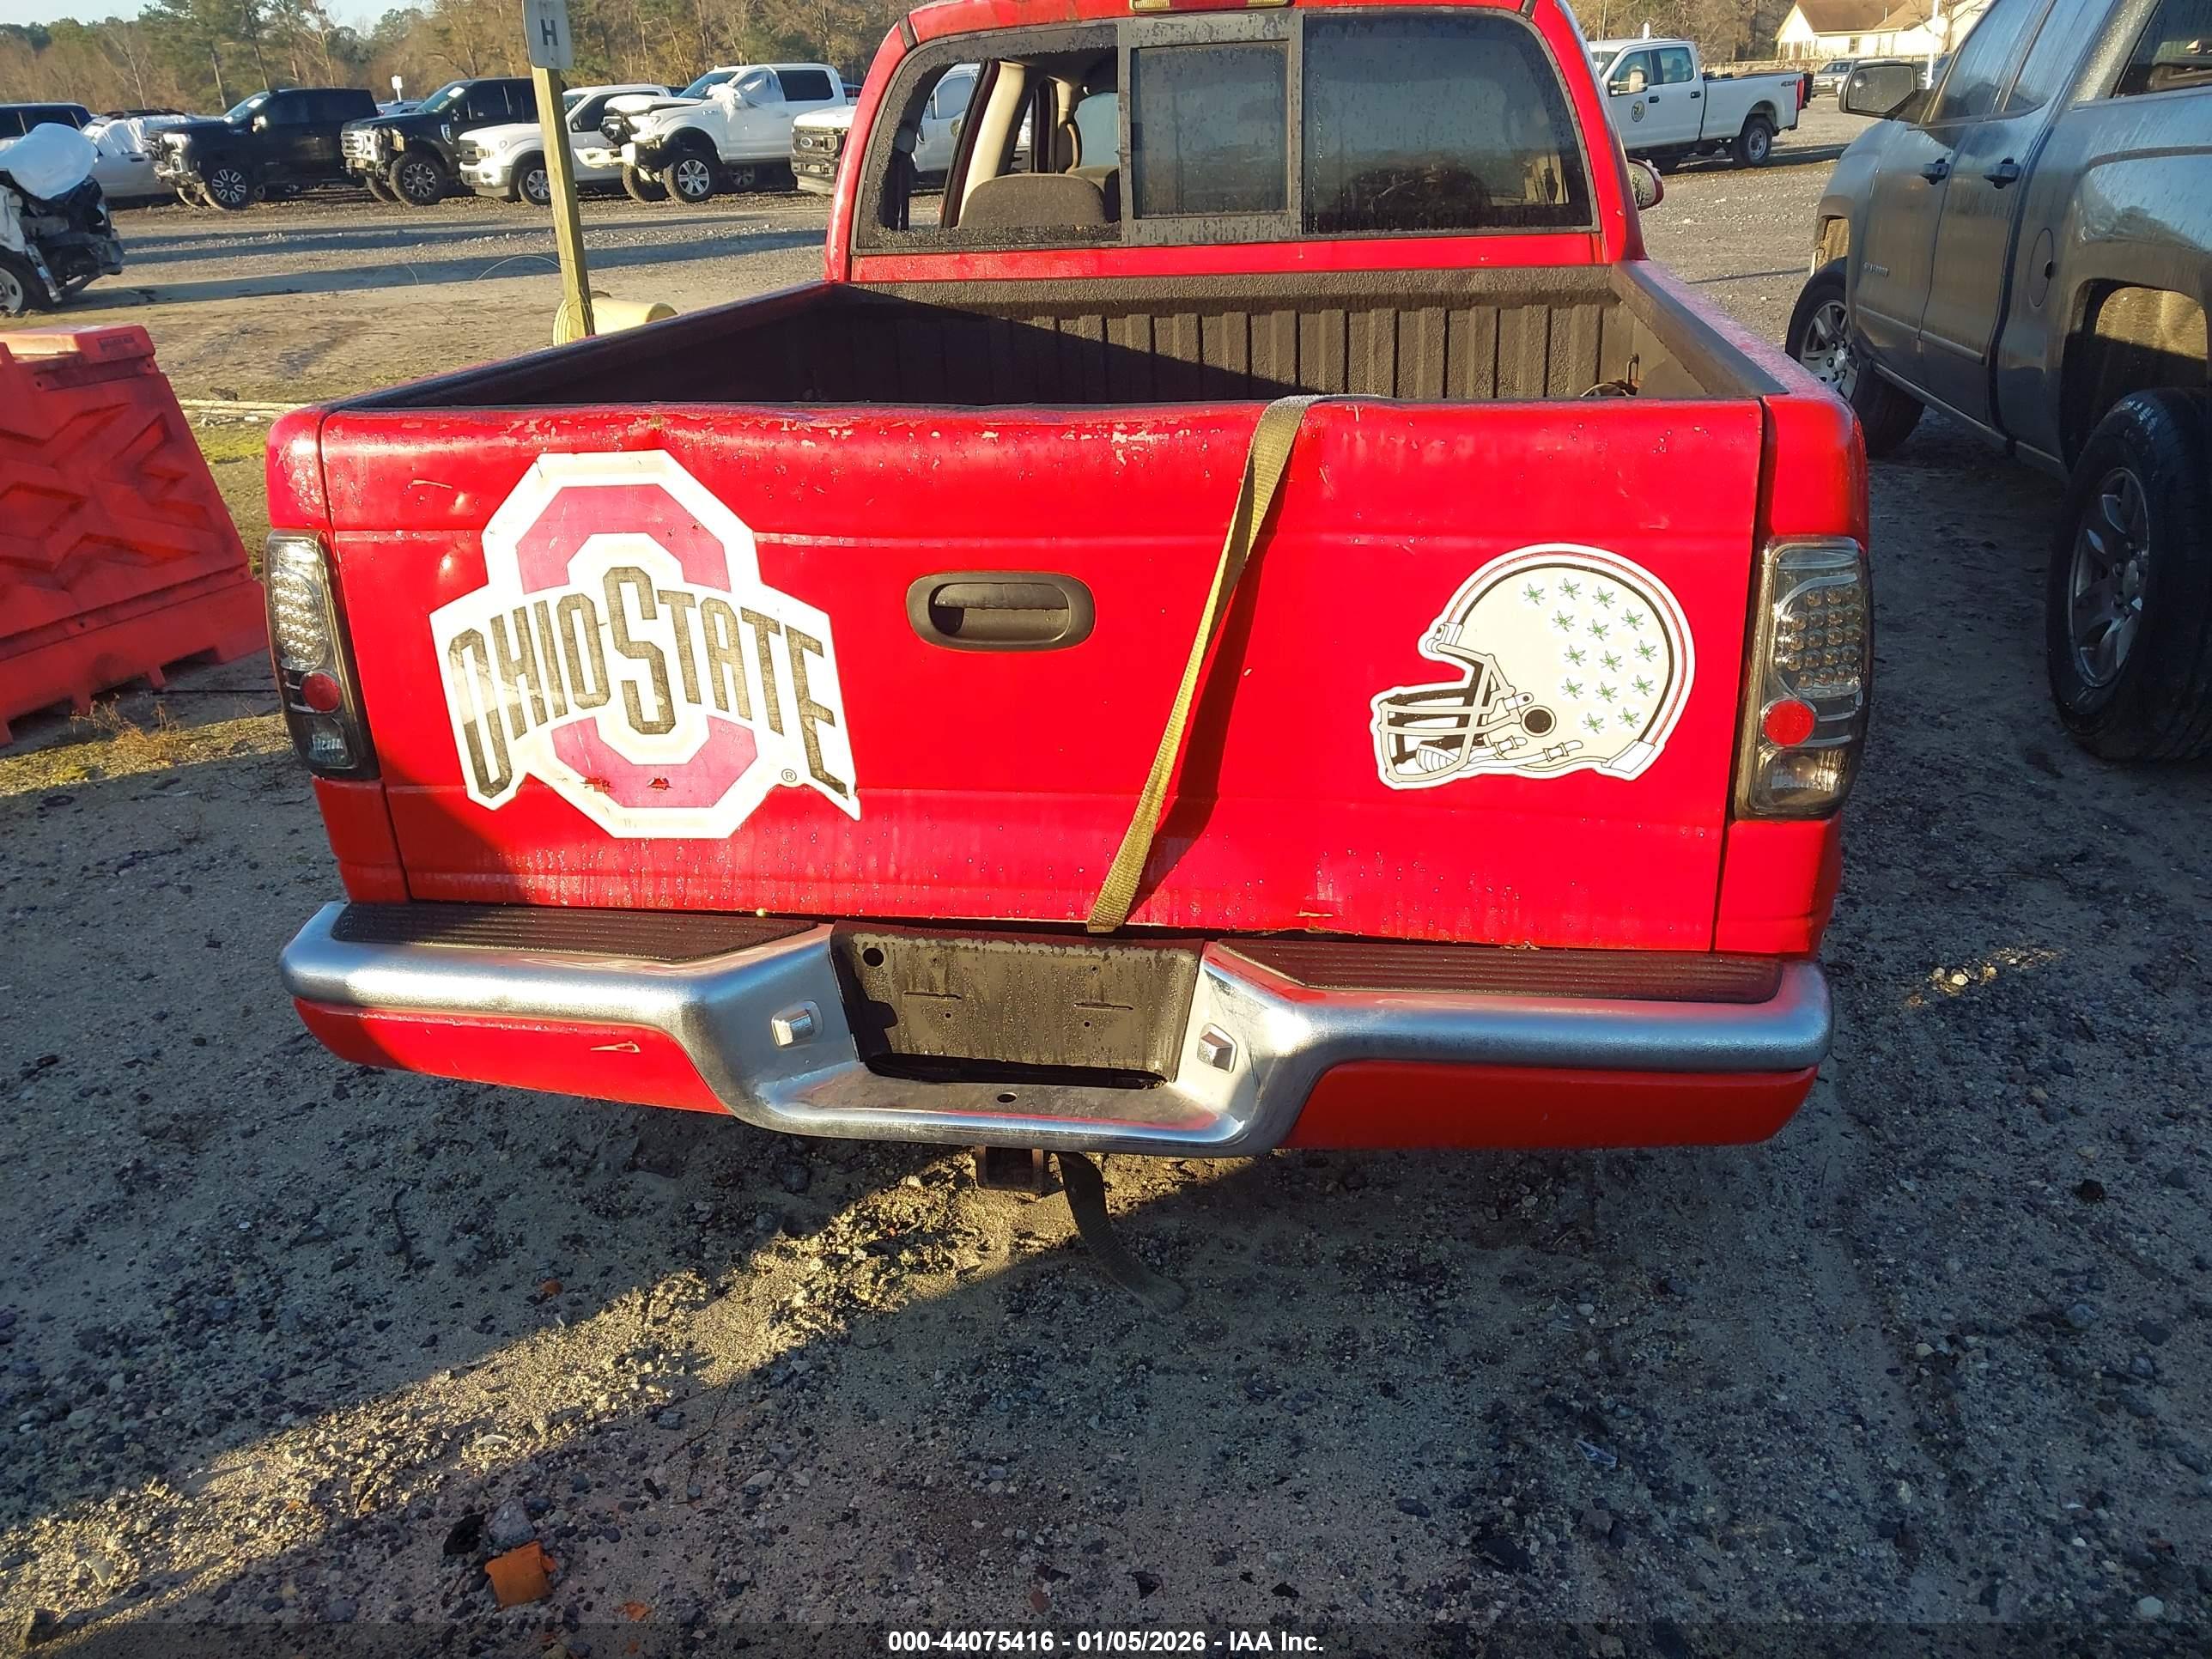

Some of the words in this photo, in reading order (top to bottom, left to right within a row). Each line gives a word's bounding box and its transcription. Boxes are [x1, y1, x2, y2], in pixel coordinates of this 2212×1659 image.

[540, 19, 558, 46] H
[447, 592, 611, 799] OHIO
[603, 566, 849, 801] STATE
